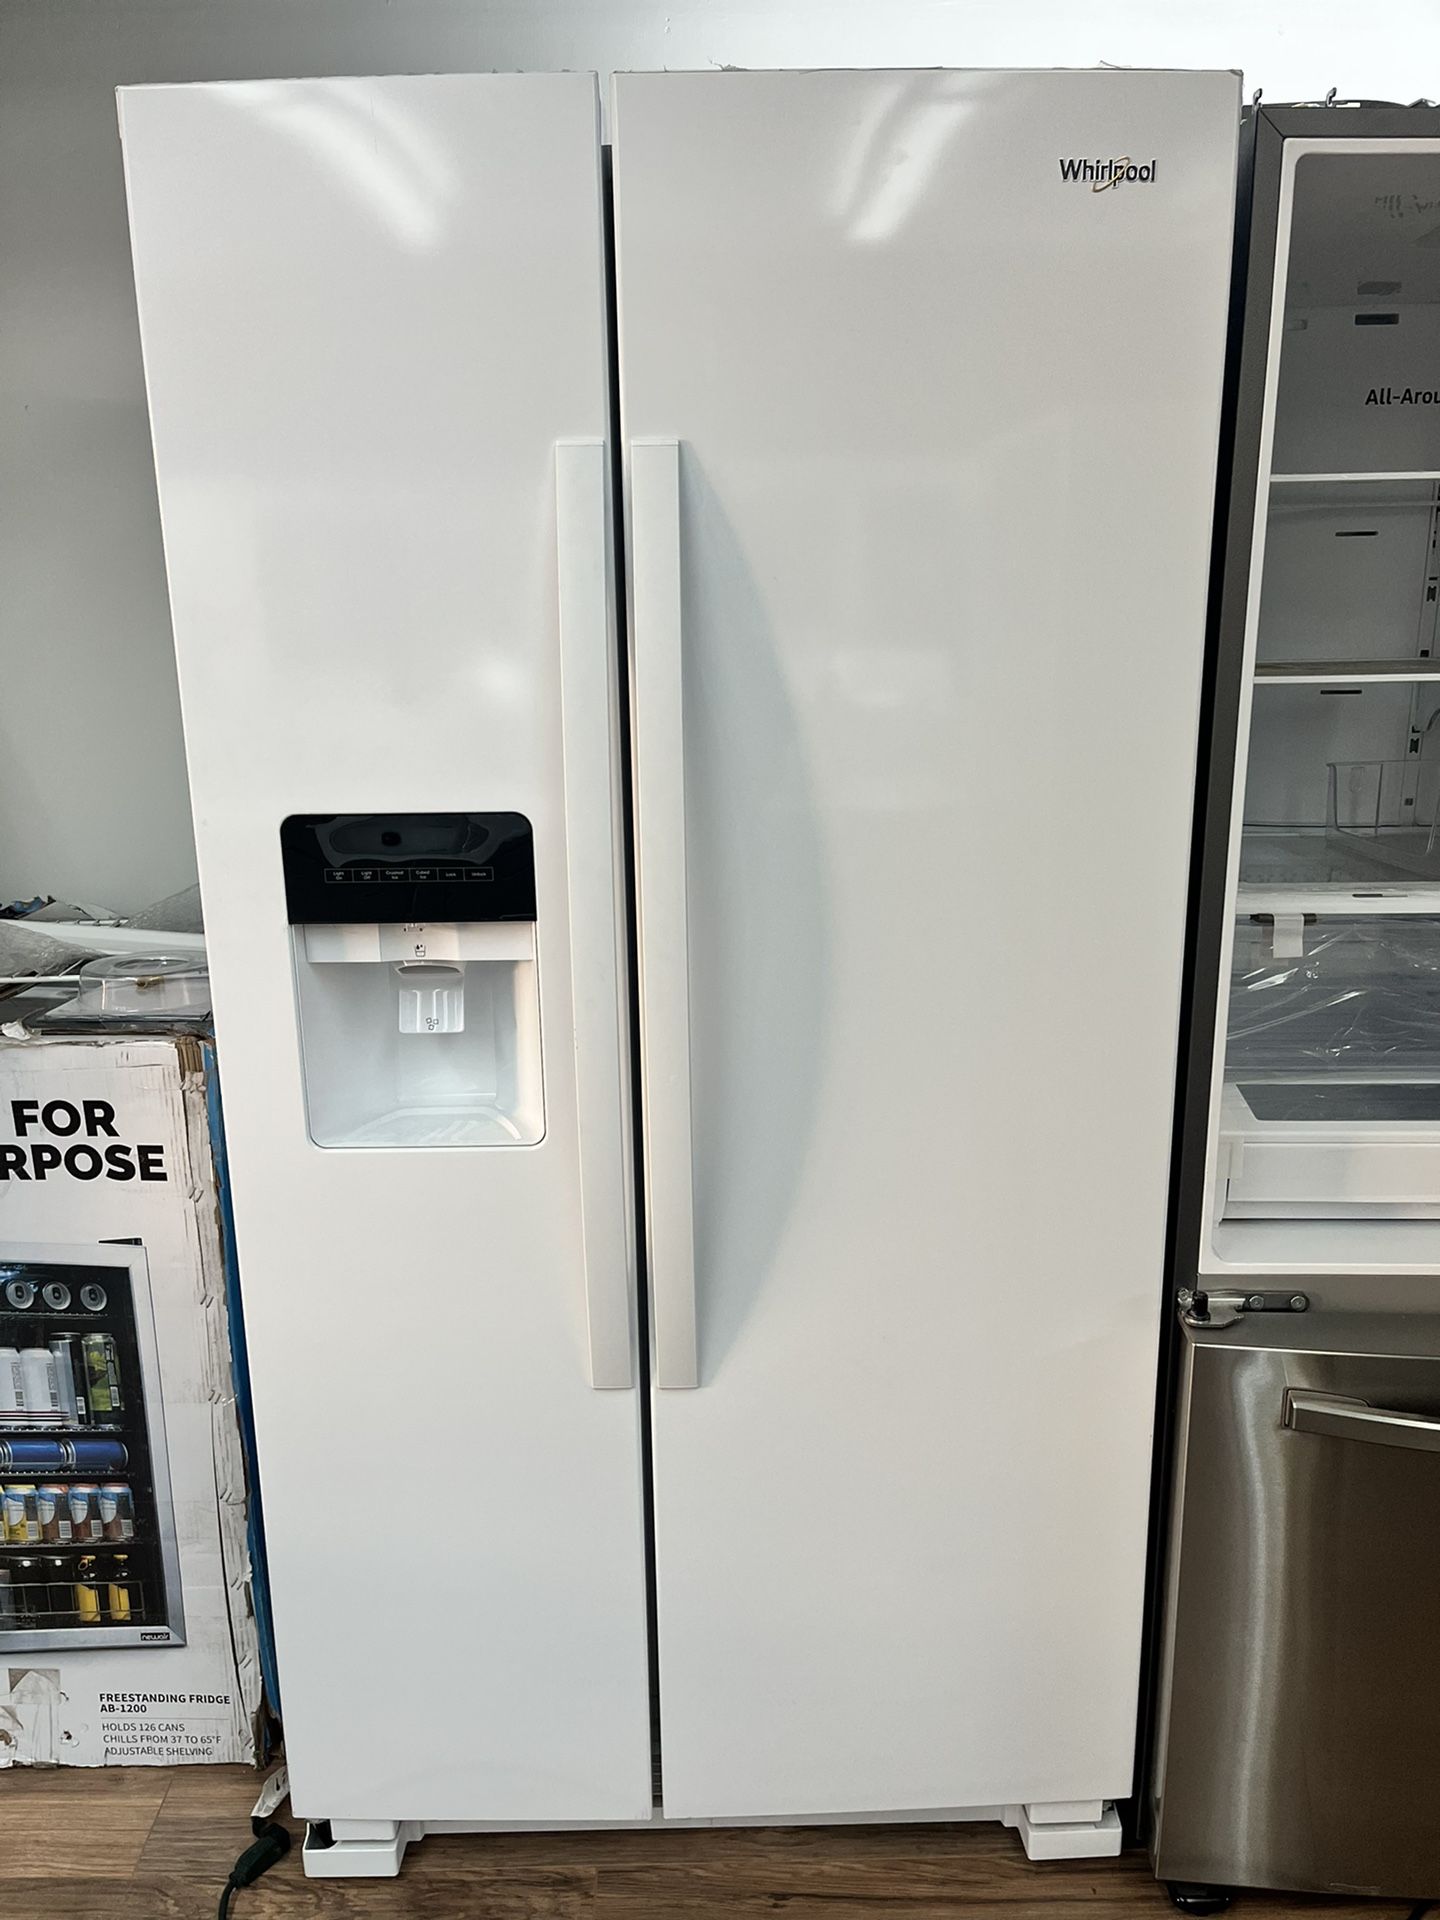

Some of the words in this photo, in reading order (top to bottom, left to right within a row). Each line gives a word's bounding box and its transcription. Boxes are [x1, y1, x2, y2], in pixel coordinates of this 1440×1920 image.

[1059, 157, 1156, 190] Whirlpool
[11, 1100, 120, 1137] FOR
[0, 1144, 168, 1181] RPOSE
[99, 1693, 186, 1703] FREESTANDING
[189, 1695, 230, 1704] FRIDGE
[100, 1704, 147, 1713] AB-1200
[102, 1723, 136, 1731] HOLDS
[140, 1723, 156, 1731] 126
[158, 1724, 185, 1732] CANS
[103, 1735, 138, 1743] CHILLS
[140, 1735, 168, 1744] FROM
[171, 1736, 182, 1744] 37
[186, 1736, 198, 1744] TO
[105, 1747, 164, 1756] ADJUSTABLE
[166, 1748, 213, 1756] SHELVING
